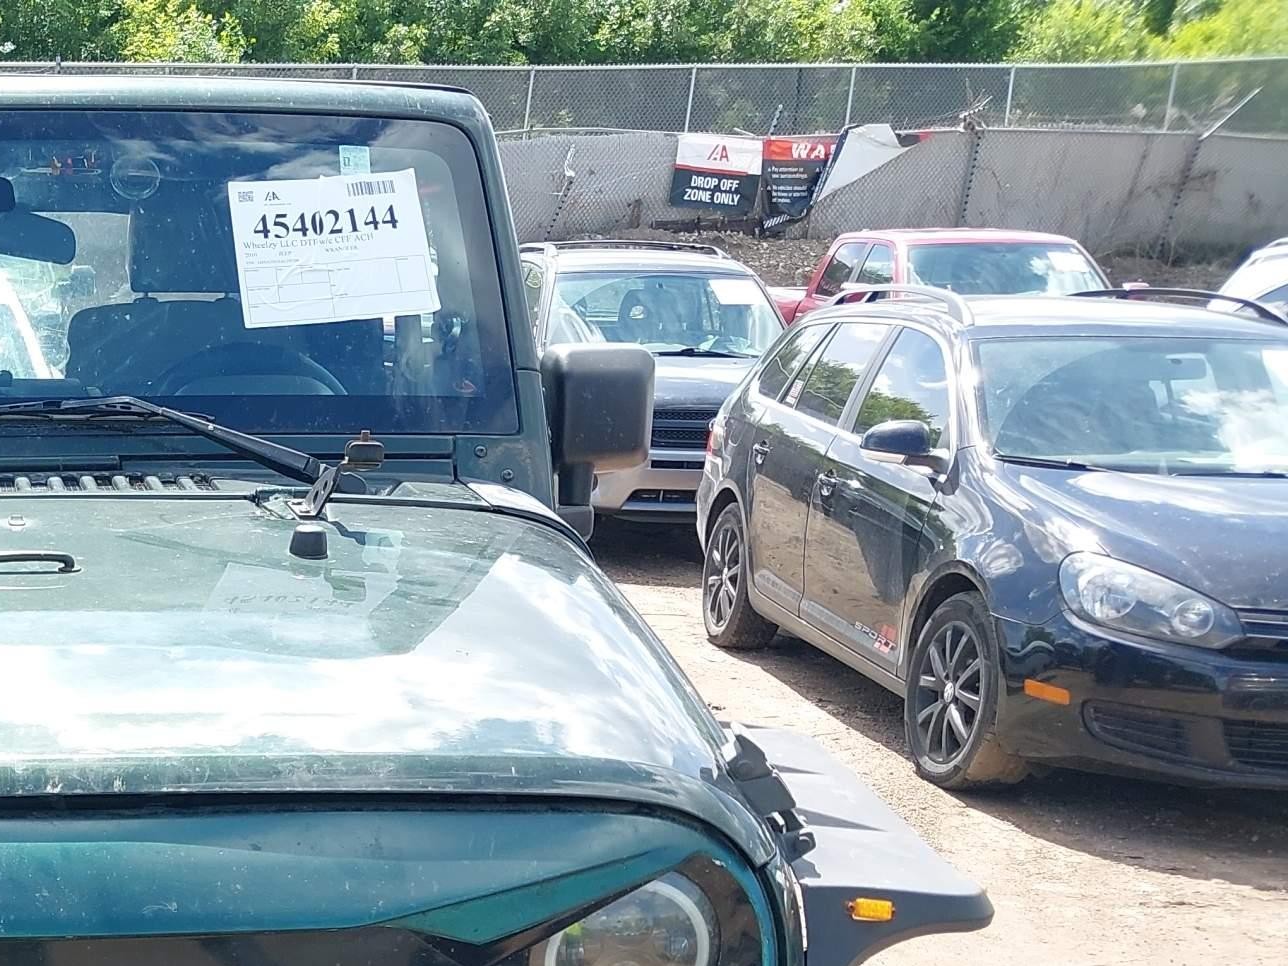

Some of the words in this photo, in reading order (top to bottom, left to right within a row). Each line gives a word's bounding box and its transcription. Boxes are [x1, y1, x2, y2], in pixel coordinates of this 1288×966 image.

[691, 175, 718, 189] DROP
[720, 179, 740, 192] OFF
[683, 188, 712, 203] ZONE
[714, 192, 740, 206] ONLY
[253, 204, 399, 239] 45402144
[280, 239, 298, 248] LLC
[854, 621, 896, 649] SPORT
